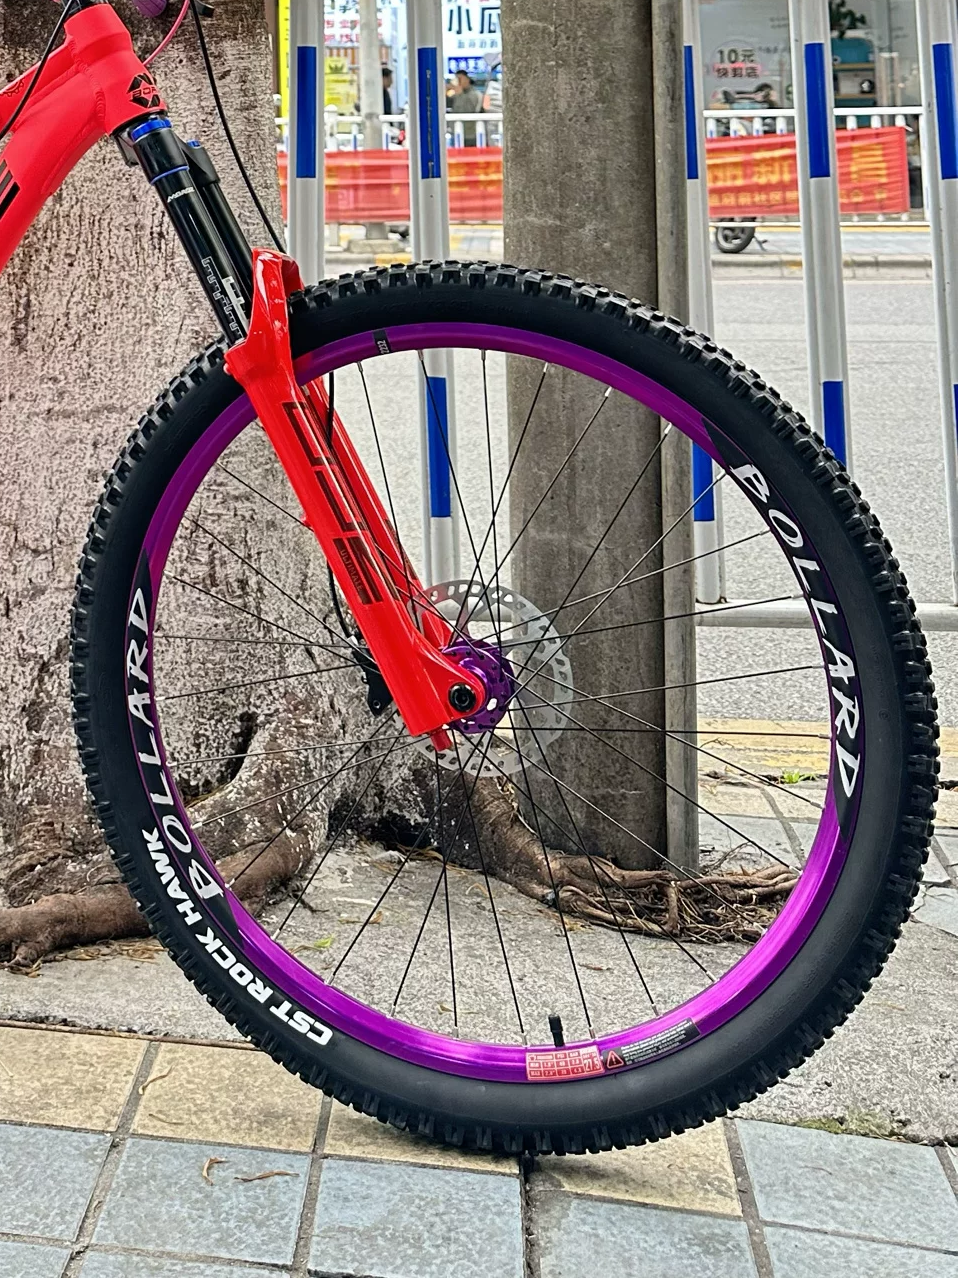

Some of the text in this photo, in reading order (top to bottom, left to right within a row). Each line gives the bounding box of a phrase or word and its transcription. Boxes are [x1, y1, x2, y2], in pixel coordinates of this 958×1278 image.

[341, 548, 364, 593] ULTIMATE
[729, 462, 860, 798] BOLLARD
[125, 586, 226, 900] BOLLARD
[142, 827, 335, 1046] CST ROCK HAWK
